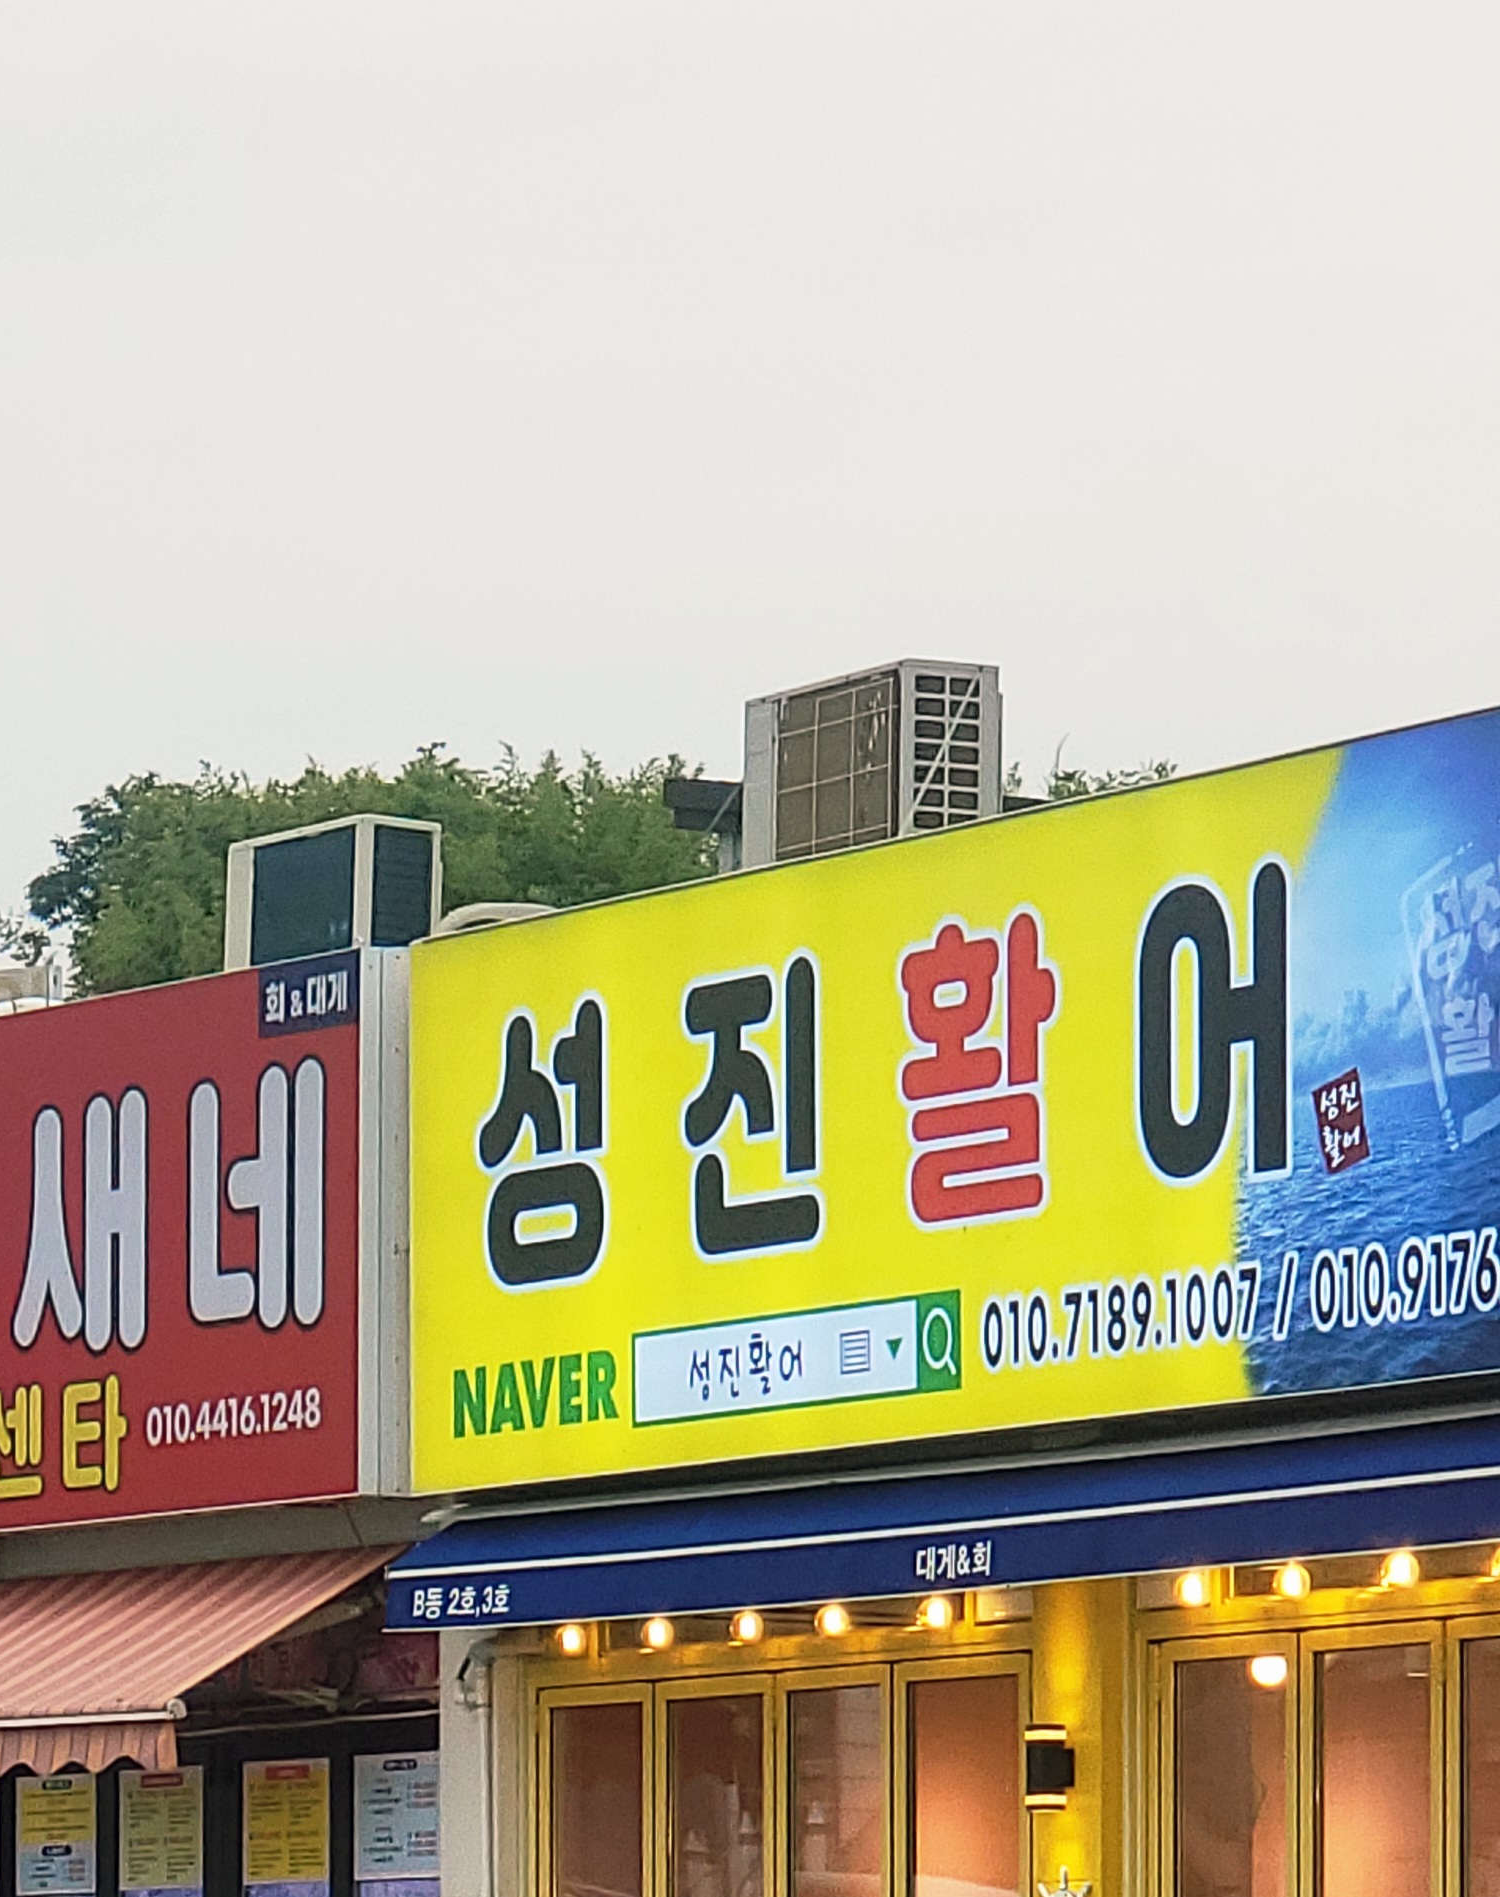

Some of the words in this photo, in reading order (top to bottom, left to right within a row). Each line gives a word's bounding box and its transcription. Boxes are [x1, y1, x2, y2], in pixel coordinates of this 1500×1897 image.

[264, 980, 285, 1024] 회
[290, 989, 303, 1014] &
[306, 969, 349, 1016] 대게
[477, 854, 1296, 1290] 성진활어
[1319, 1081, 1361, 1120] 성진
[1321, 1124, 1362, 1168] 활어
[980, 1263, 1259, 1370] 010.7189.1007
[1308, 1226, 1500, 1331] 010.9176
[452, 1349, 619, 1439] NAVER
[687, 1331, 805, 1402] 성진활어
[145, 1386, 323, 1448] 010.4416.1248
[915, 1540, 993, 1582] 대게&회
[411, 1587, 443, 1620] B동
[448, 1583, 511, 1619] 2호,3호
